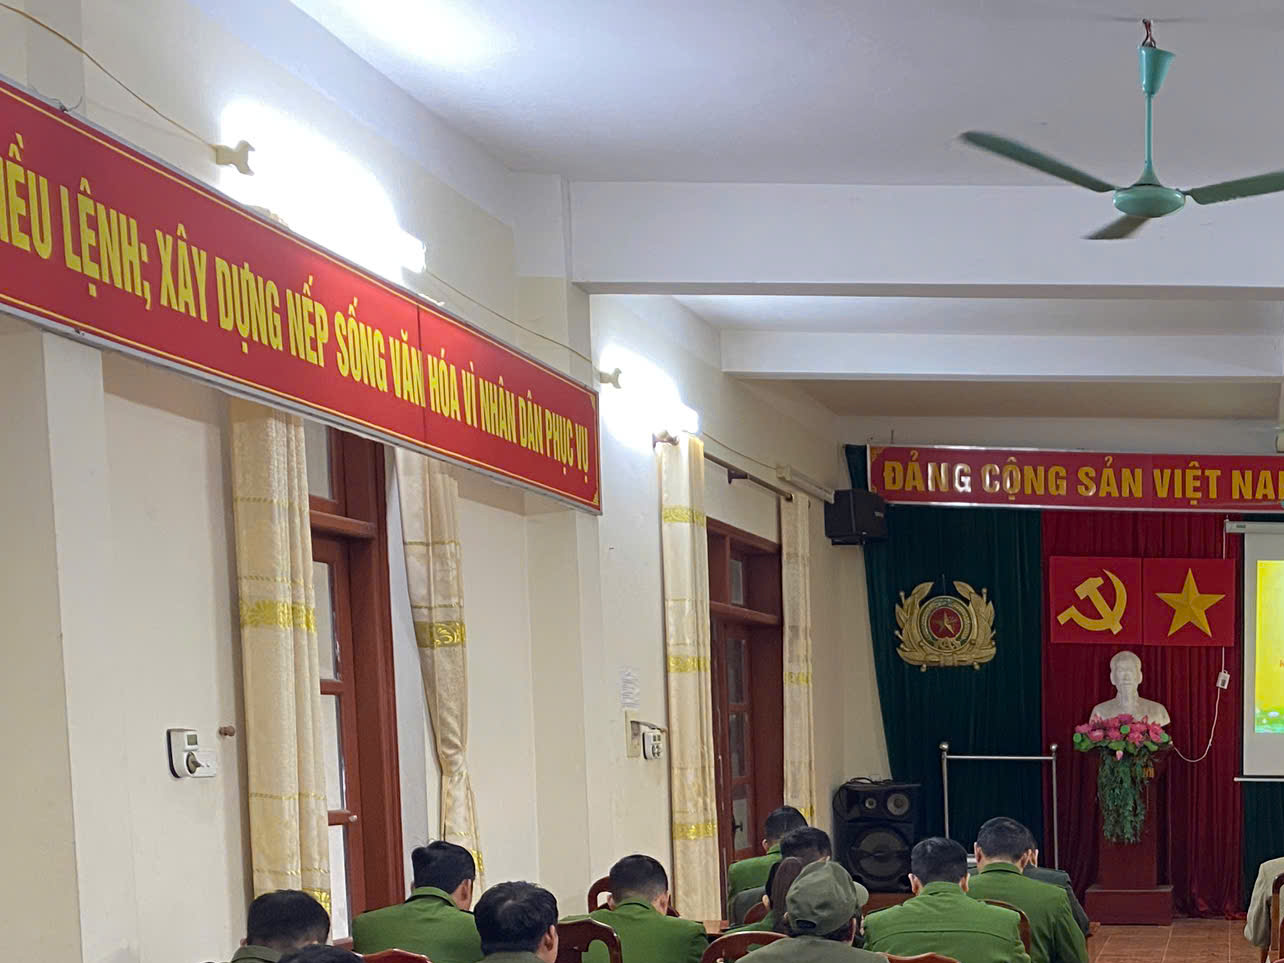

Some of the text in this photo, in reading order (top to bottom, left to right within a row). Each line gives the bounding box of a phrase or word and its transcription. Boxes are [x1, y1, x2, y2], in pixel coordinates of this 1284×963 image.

[60, 177, 151, 310] LỆNH;
[156, 223, 208, 321] XÂY
[215, 256, 284, 354] DỰNG
[286, 275, 329, 367] NẾP
[335, 297, 388, 393] SỐNG
[389, 328, 427, 409] VĂN
[427, 348, 461, 421] HÓA
[461, 361, 478, 428] VÌ
[479, 376, 518, 444] NHÂN
[518, 390, 544, 456] DÂN
[545, 408, 575, 475] PHỤC
[575, 423, 590, 483] VỤ
[883, 450, 972, 493] ĐẢNG
[981, 456, 1067, 500] CỘNG
[1077, 456, 1143, 499] SẢN
[1153, 461, 1221, 505] VIỆT
